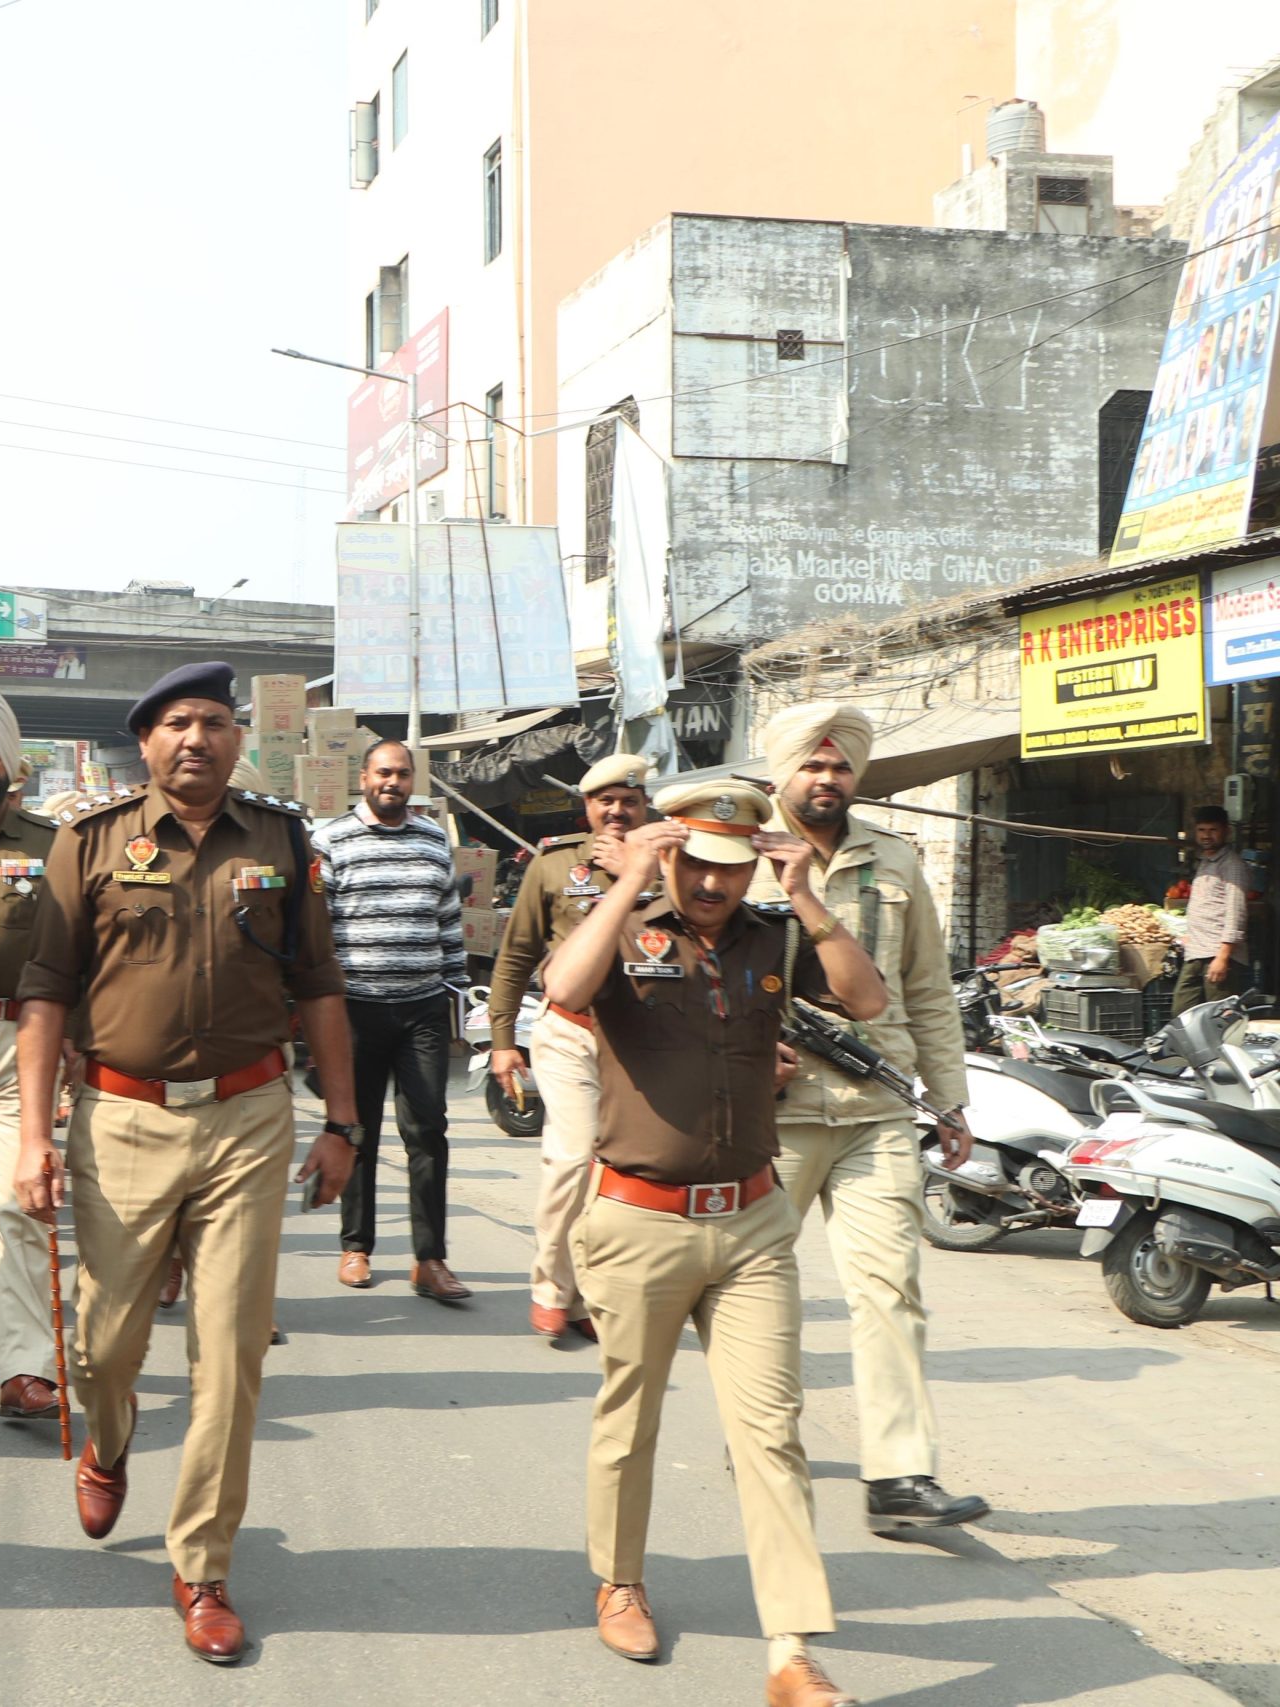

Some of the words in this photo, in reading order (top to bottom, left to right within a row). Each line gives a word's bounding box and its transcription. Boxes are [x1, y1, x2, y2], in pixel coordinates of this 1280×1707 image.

[796, 550, 876, 581] Market
[882, 550, 934, 582] Near
[814, 583, 904, 607] GORAYA
[1023, 631, 1035, 666] R
[1040, 627, 1053, 662] K
[1058, 596, 1196, 660] ENTERPRISES
[1057, 664, 1113, 686] WESTERN
[1073, 679, 1113, 698] UNION
